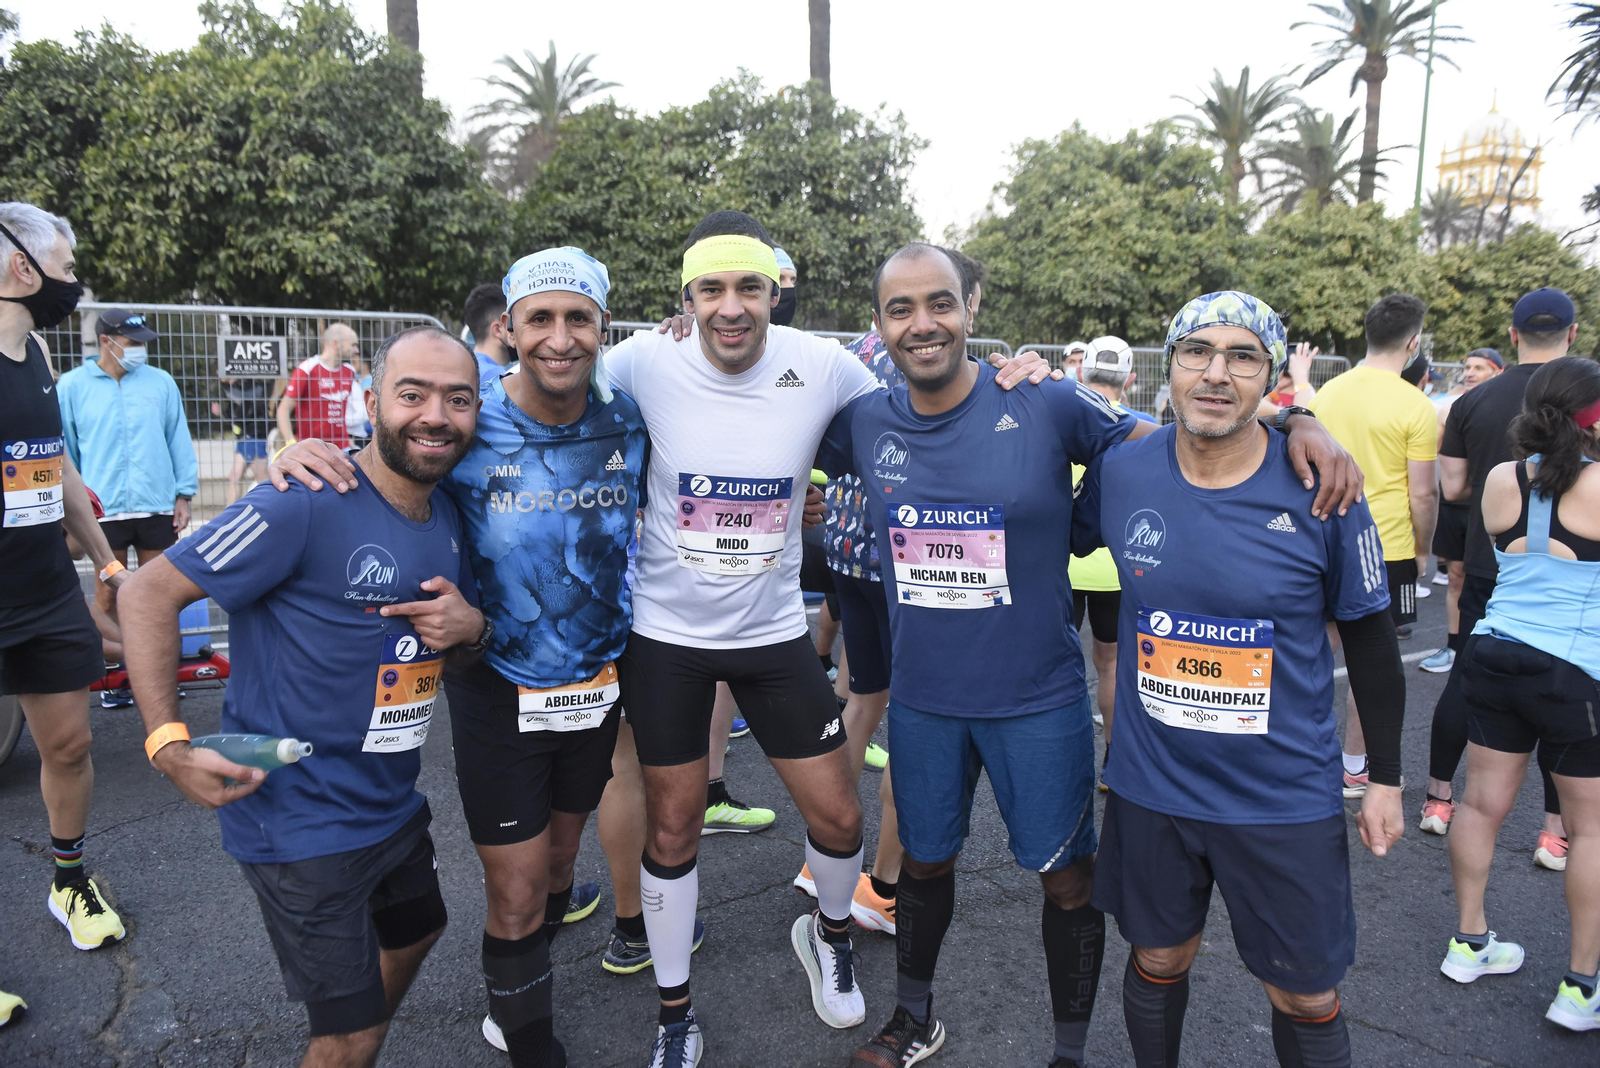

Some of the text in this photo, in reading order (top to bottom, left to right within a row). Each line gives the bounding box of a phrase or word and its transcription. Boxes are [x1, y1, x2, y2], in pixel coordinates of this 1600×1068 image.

[528, 261, 574, 274] SEVILLA
[528, 276, 576, 290] ZURICH
[233, 342, 272, 360] AMS
[994, 422, 1019, 432] adidas
[30, 442, 60, 455] ZURICH
[876, 446, 907, 465] RUN
[484, 464, 522, 478] CMM
[605, 462, 627, 470] adidas
[716, 482, 779, 496] ZURICH
[490, 484, 628, 514] MOROCCO
[715, 512, 752, 528] 7240
[922, 510, 988, 524] ZURICH
[1127, 524, 1162, 546] RUN
[1266, 522, 1296, 533] adidas
[716, 538, 748, 550] MIDO
[926, 544, 964, 560] 7079
[351, 561, 394, 585] RUN
[910, 568, 986, 584] HICHAM BEN
[1177, 620, 1255, 642] ZURICH
[1176, 657, 1222, 678] 4366
[545, 690, 604, 708] ABDELHAK
[1141, 676, 1266, 706] ABDELOUAHDFAIZ
[380, 702, 433, 724] MOHAMED
[1152, 705, 1165, 714] asics
